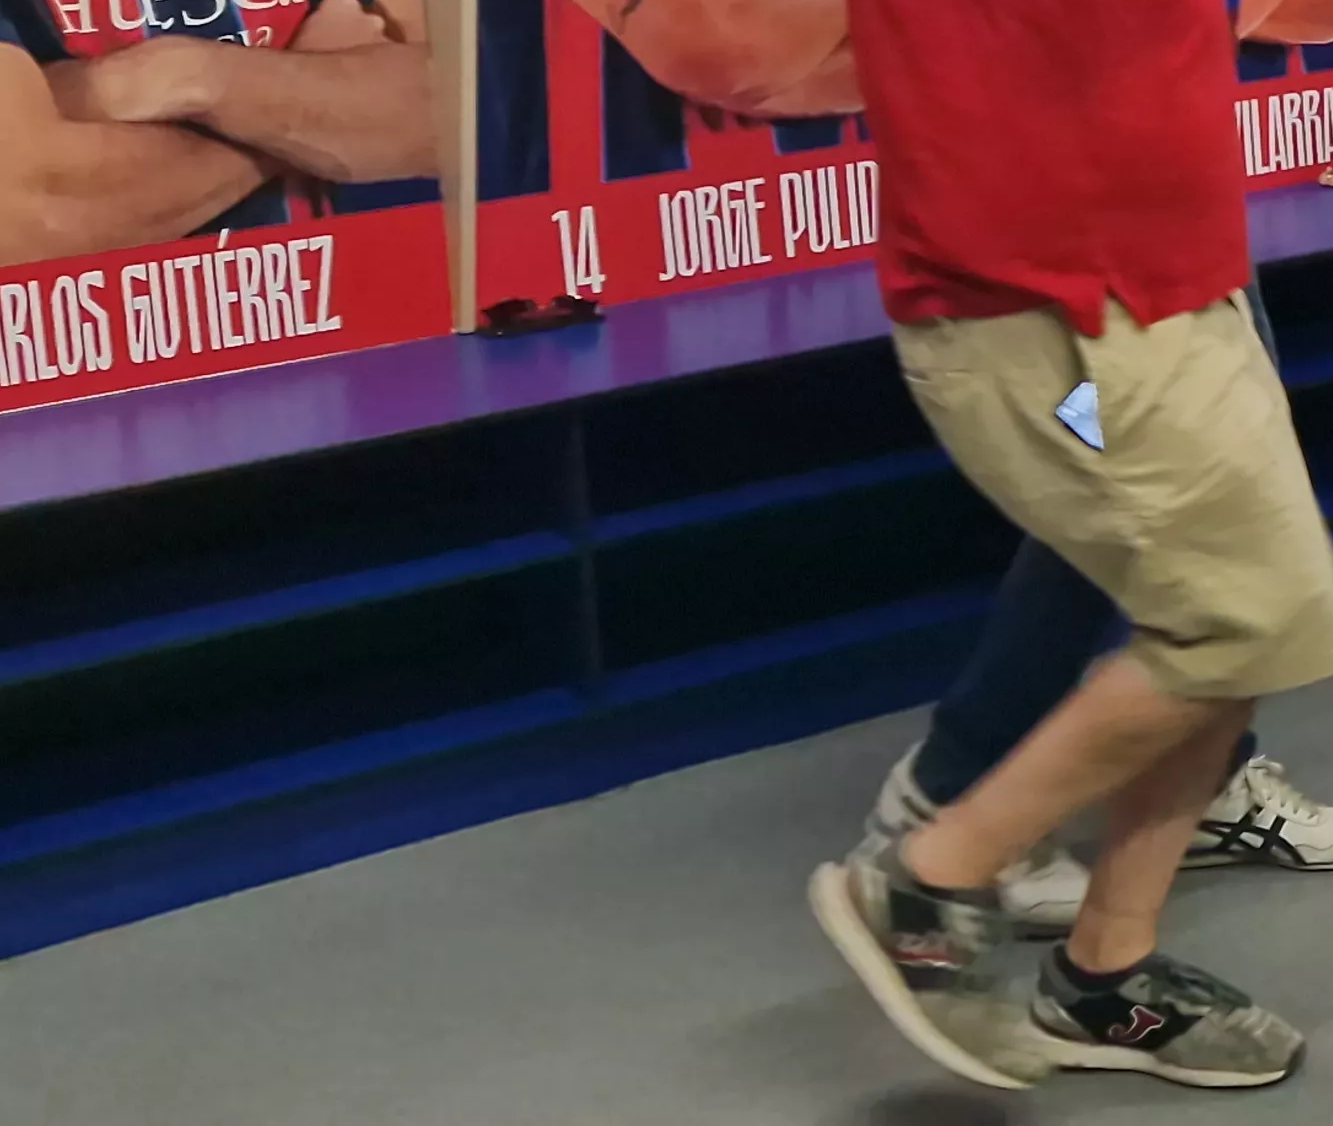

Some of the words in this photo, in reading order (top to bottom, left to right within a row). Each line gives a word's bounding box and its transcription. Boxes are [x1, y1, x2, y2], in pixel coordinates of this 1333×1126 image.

[121, 228, 342, 364] GUTIÉRREZ
[551, 205, 607, 300] 14
[659, 177, 772, 282] JORGE
